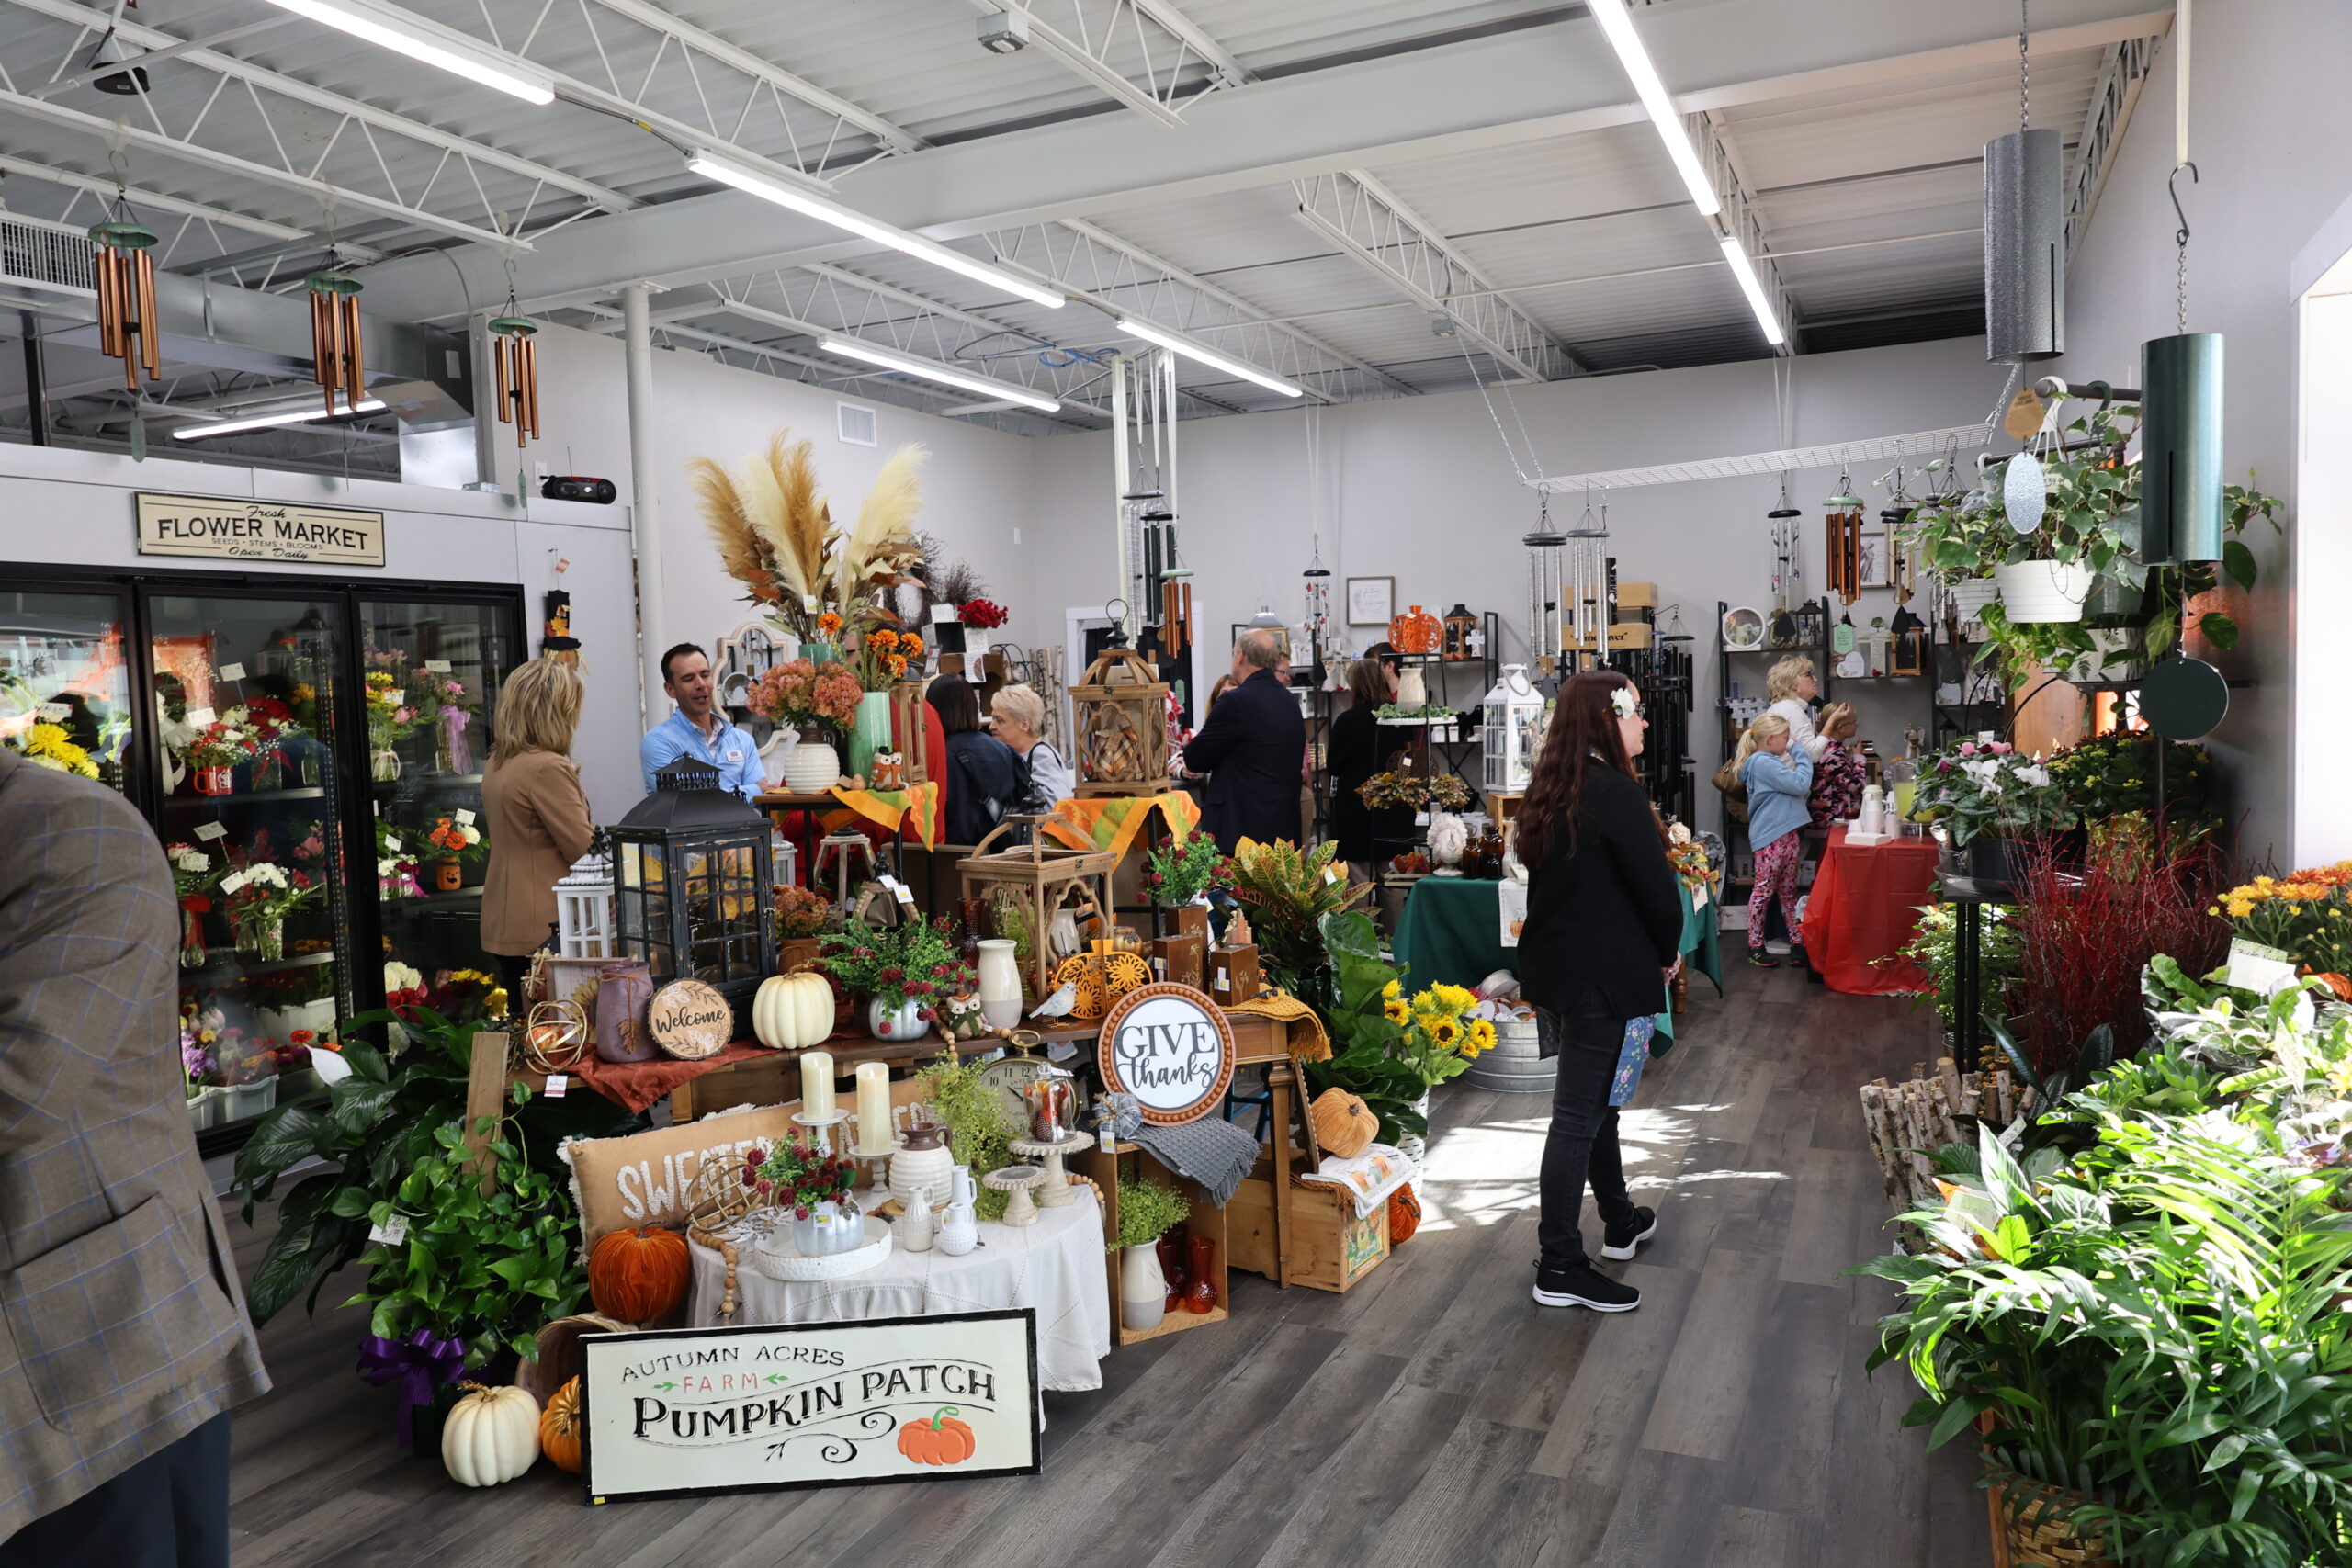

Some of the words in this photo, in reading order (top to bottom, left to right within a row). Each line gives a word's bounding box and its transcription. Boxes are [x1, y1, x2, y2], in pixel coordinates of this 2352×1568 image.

[246, 506, 287, 519] Fresh
[157, 517, 263, 539] FLOWER
[275, 521, 368, 550] MARKET
[211, 537, 239, 546] SEEDS
[249, 539, 277, 547] STEMS
[287, 541, 323, 550] BLOOMS
[228, 547, 264, 557] Open
[272, 547, 309, 560] Daily
[655, 1006, 726, 1033] Welcome
[1115, 1021, 1216, 1059] GIVE
[989, 1077, 999, 1086] 10
[1021, 1067, 1030, 1077] 12
[1116, 1053, 1219, 1089] thanks
[621, 1347, 740, 1383] AUTUMN
[756, 1345, 844, 1367] ACRES
[684, 1372, 759, 1394] FARM
[632, 1380, 844, 1439] PUMPKIN
[861, 1364, 996, 1403] PATCH
